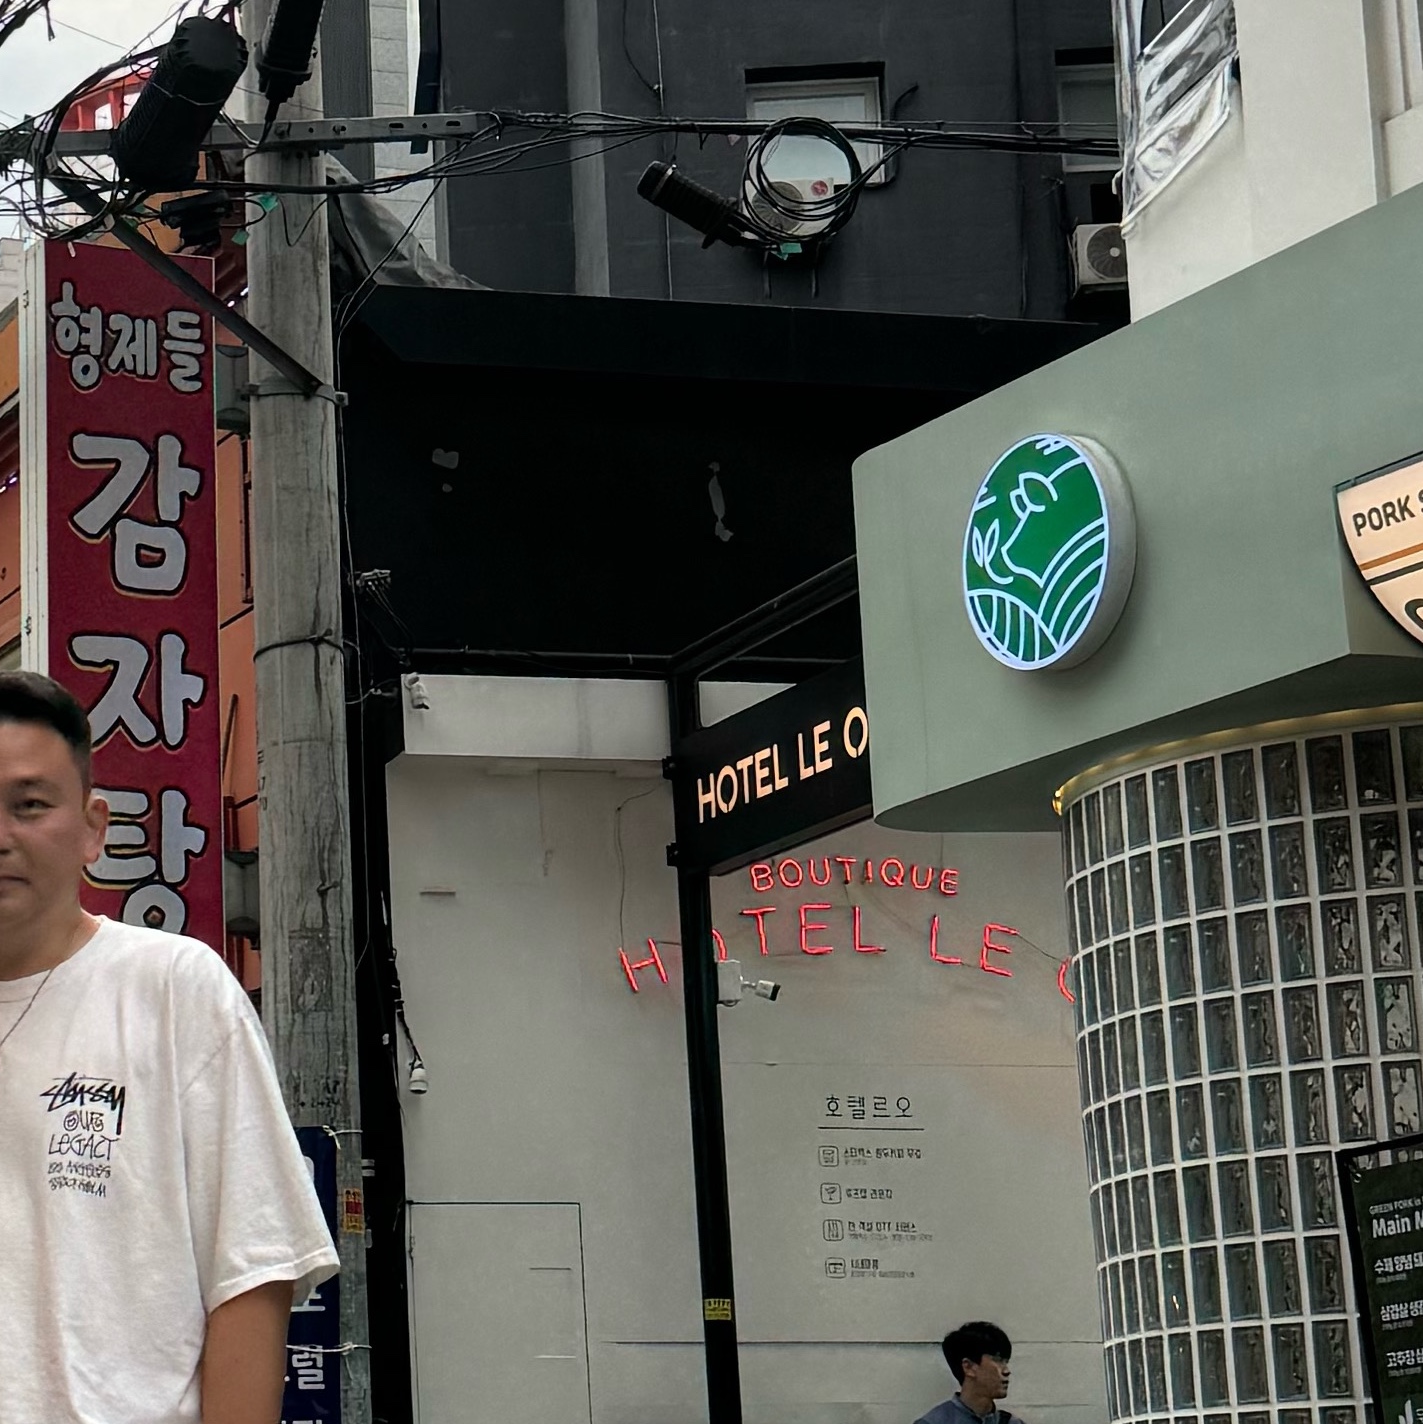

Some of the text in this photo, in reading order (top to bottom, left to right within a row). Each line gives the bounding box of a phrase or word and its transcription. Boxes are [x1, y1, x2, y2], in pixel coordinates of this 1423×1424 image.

[51, 282, 205, 392] 형제들
[1353, 494, 1416, 536] PORK
[71, 433, 208, 933] 감자탕
[698, 706, 868, 823] HOTEL LE O
[751, 857, 960, 896] BOUTIQUE
[930, 914, 1018, 977] LE
[826, 1094, 913, 1120] 호텔르오
[1372, 1215, 1411, 1238] Main
